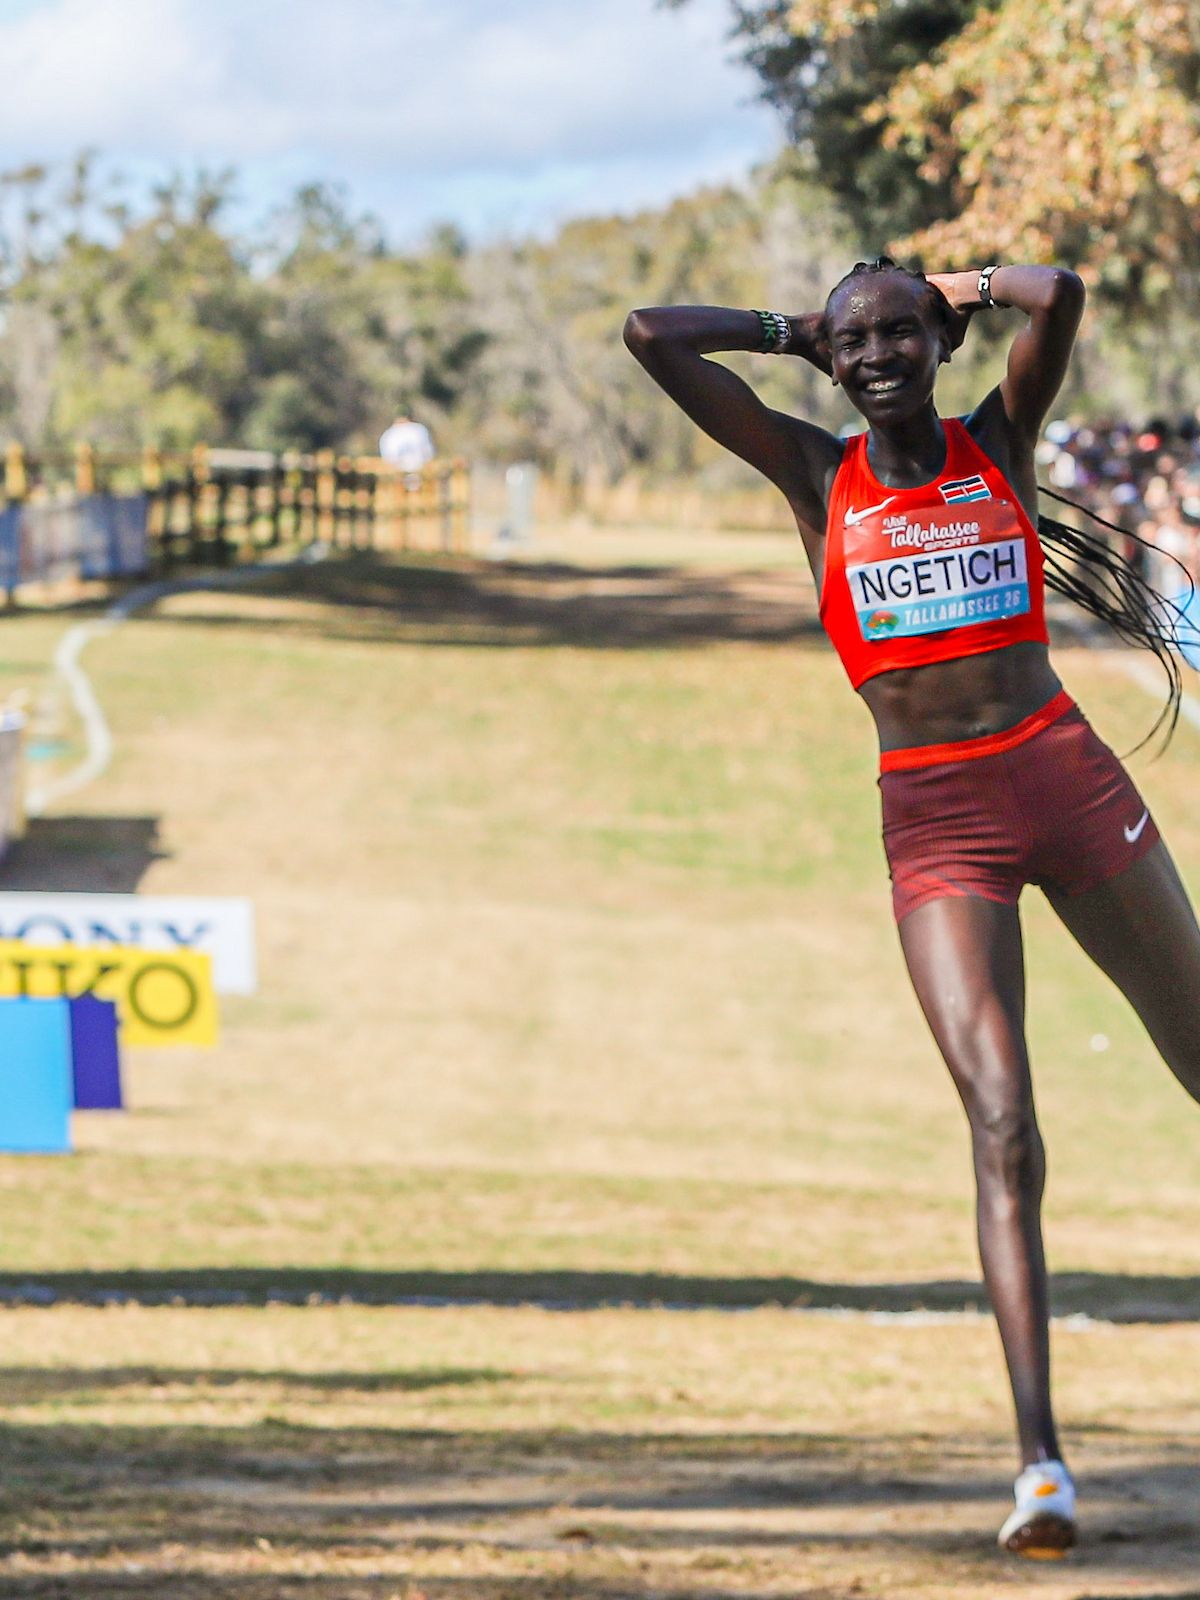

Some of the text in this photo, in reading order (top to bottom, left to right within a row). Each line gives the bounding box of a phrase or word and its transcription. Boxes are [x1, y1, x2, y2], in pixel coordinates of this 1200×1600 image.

[881, 521, 980, 548] Tallahassee
[924, 534, 979, 551] SPORTS
[858, 545, 1017, 604] NGETICH
[904, 595, 1000, 626] TALLAHASSEE
